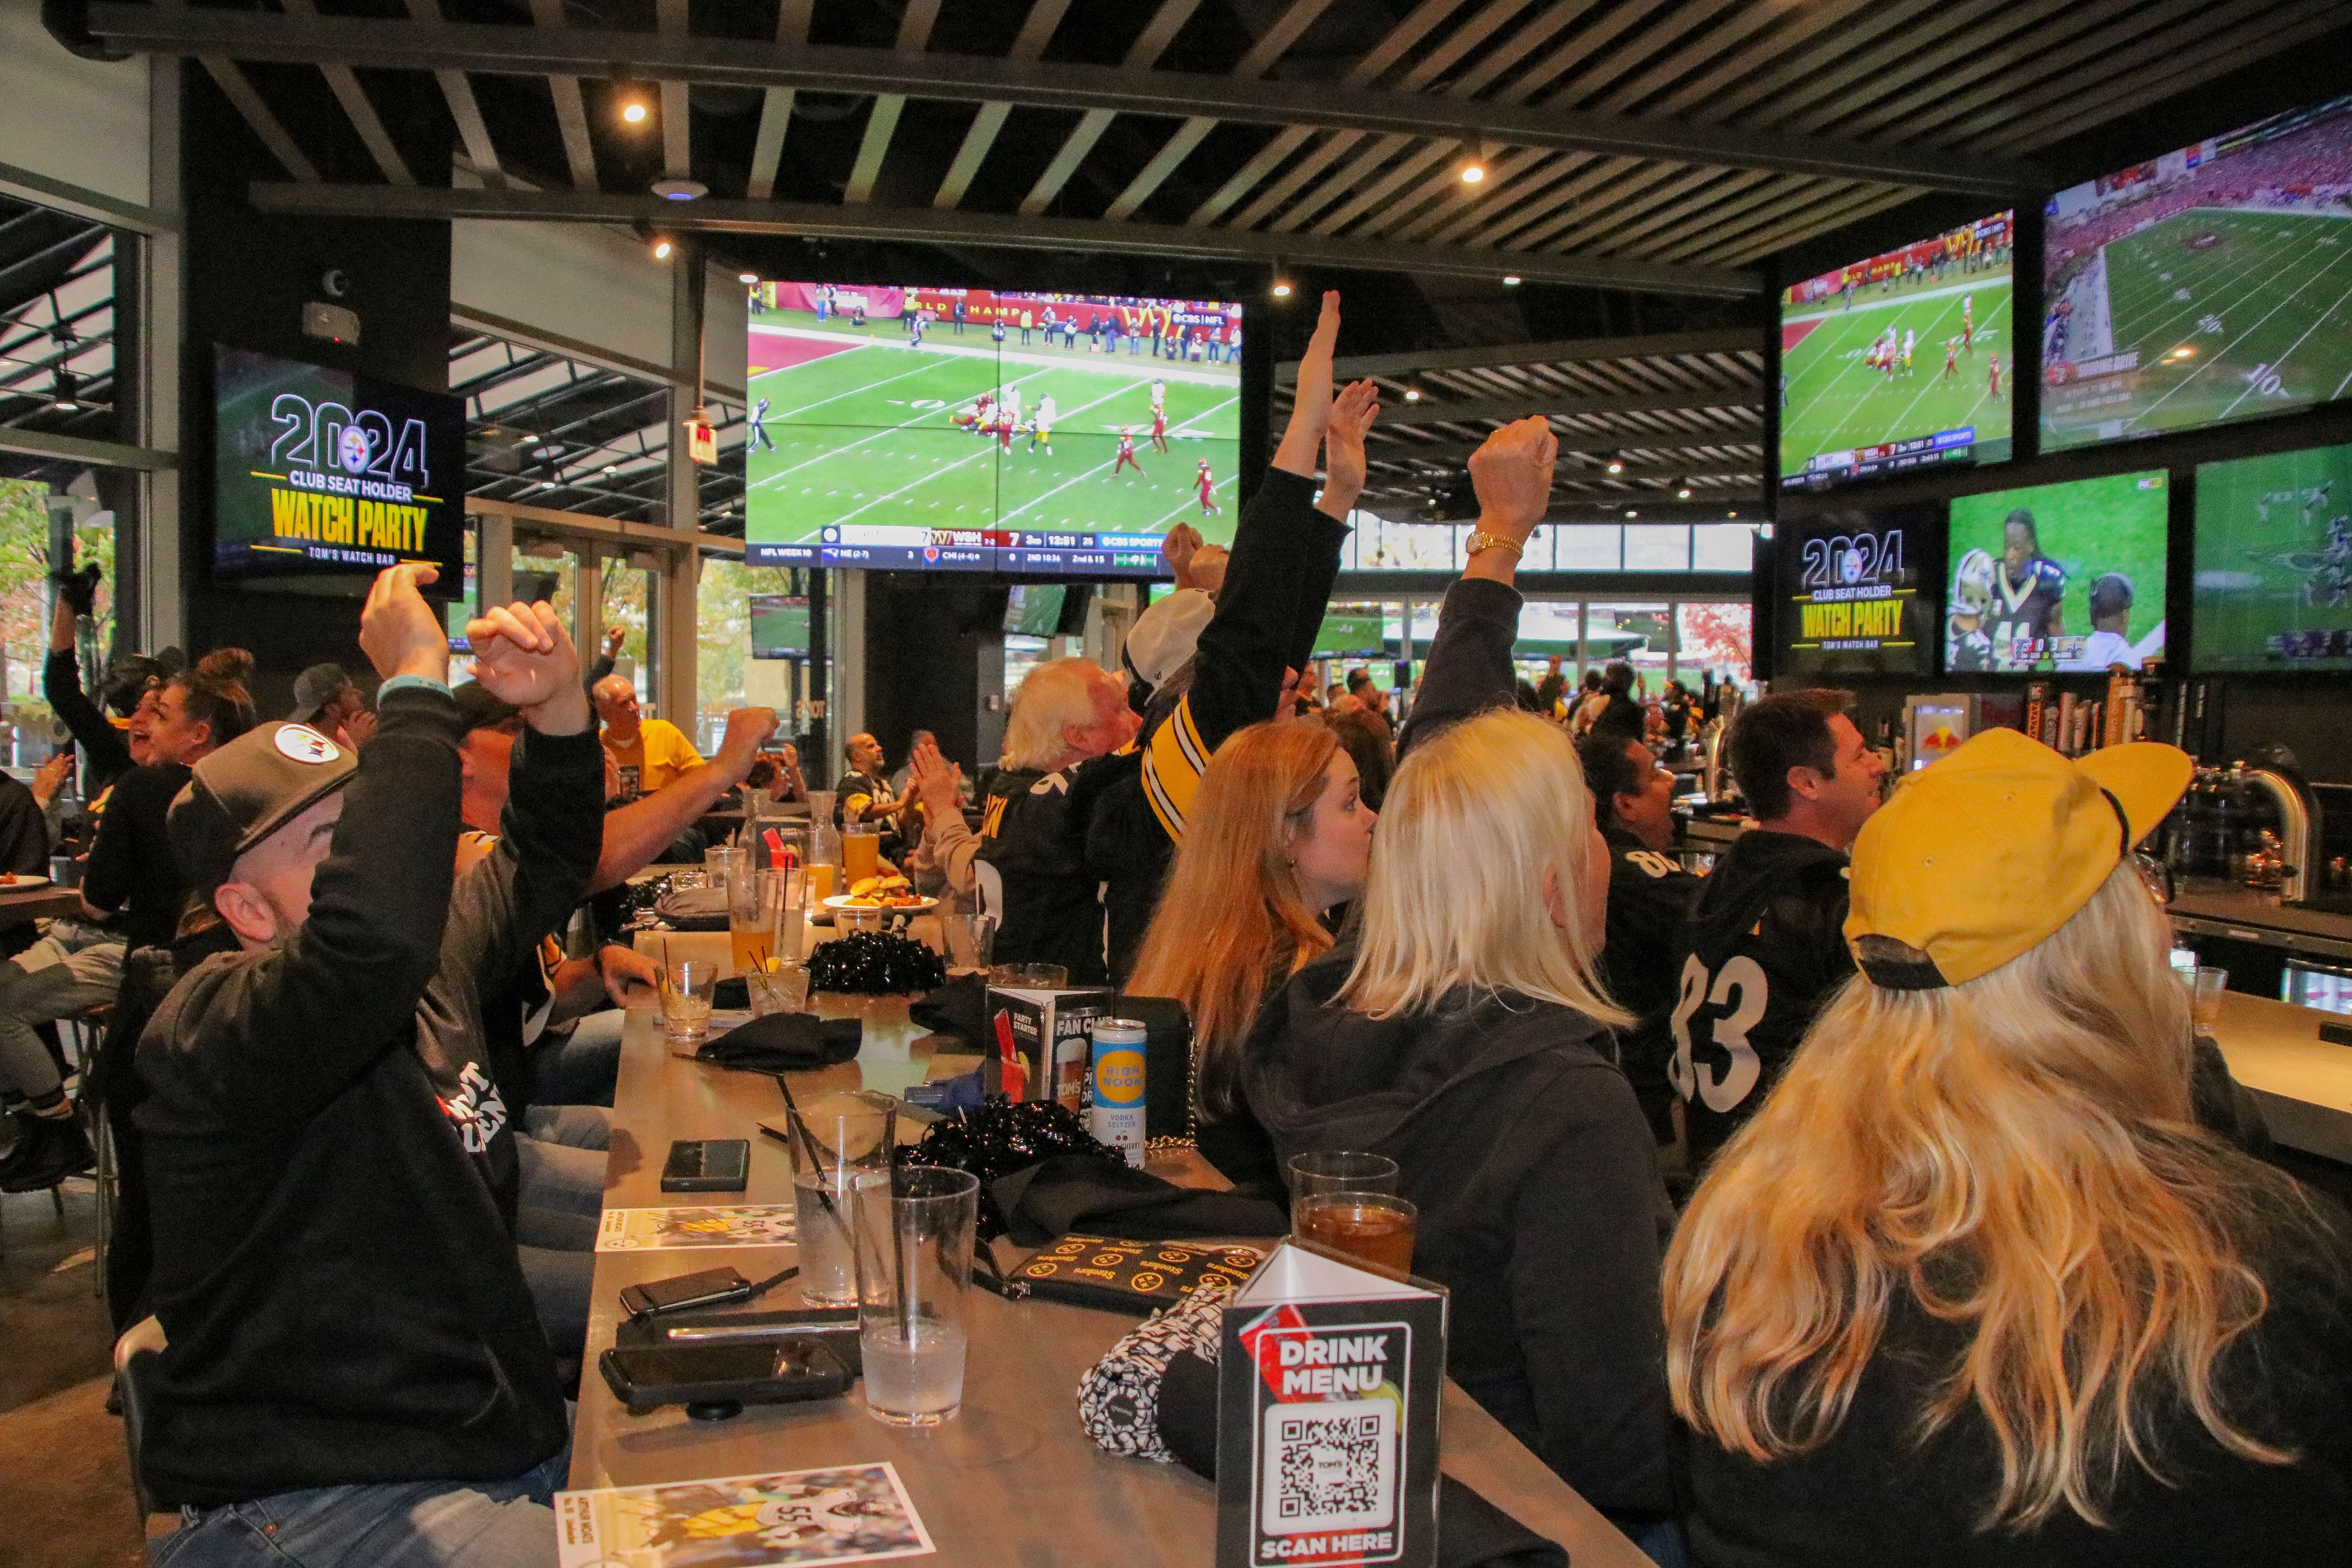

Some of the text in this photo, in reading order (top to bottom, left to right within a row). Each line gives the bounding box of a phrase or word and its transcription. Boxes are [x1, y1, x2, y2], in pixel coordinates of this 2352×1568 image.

[1183, 314, 1225, 325] CBS NFL
[271, 393, 430, 490] 2024
[1889, 443, 1896, 455] 7
[289, 470, 413, 502] CLUB SEAT HOLDER
[271, 487, 429, 552] WATCH PARTY
[864, 530, 928, 542] PIT 7
[953, 531, 982, 542] WSH
[1009, 532, 1019, 547] 7
[1049, 535, 1075, 546] 12:51
[309, 546, 395, 566] TOM'S WATCH BAR
[760, 548, 777, 557] NFL
[777, 548, 802, 557] WEEK
[840, 549, 852, 557] NE
[942, 551, 957, 559] CHI
[1072, 554, 1087, 564] 2nd
[1802, 530, 1905, 589] 2024
[1813, 584, 1892, 602] CLUB SEAT HOLDER
[1802, 600, 1904, 638] WATCH PARTY
[1842, 640, 1864, 649] WATCH
[1865, 640, 1879, 649] BAR
[1014, 1012, 1032, 1025] PARTY
[1013, 1020, 1038, 1036] STARTER
[1056, 1018, 1082, 1036] FAN
[1106, 1066, 1140, 1076] HIGH
[1057, 1079, 1082, 1096] TOM'S
[1103, 1078, 1142, 1087] NOON
[1073, 1268, 1116, 1280] Steelers
[1140, 1261, 1183, 1274] Steelers
[1206, 1262, 1250, 1281] Steelers
[1280, 1335, 1388, 1367] DRINK
[1283, 1365, 1383, 1396] MENU
[777, 1506, 813, 1522] 55
[581, 1522, 594, 1544] MOATS
[1260, 1532, 1394, 1559] SCAN HERE
